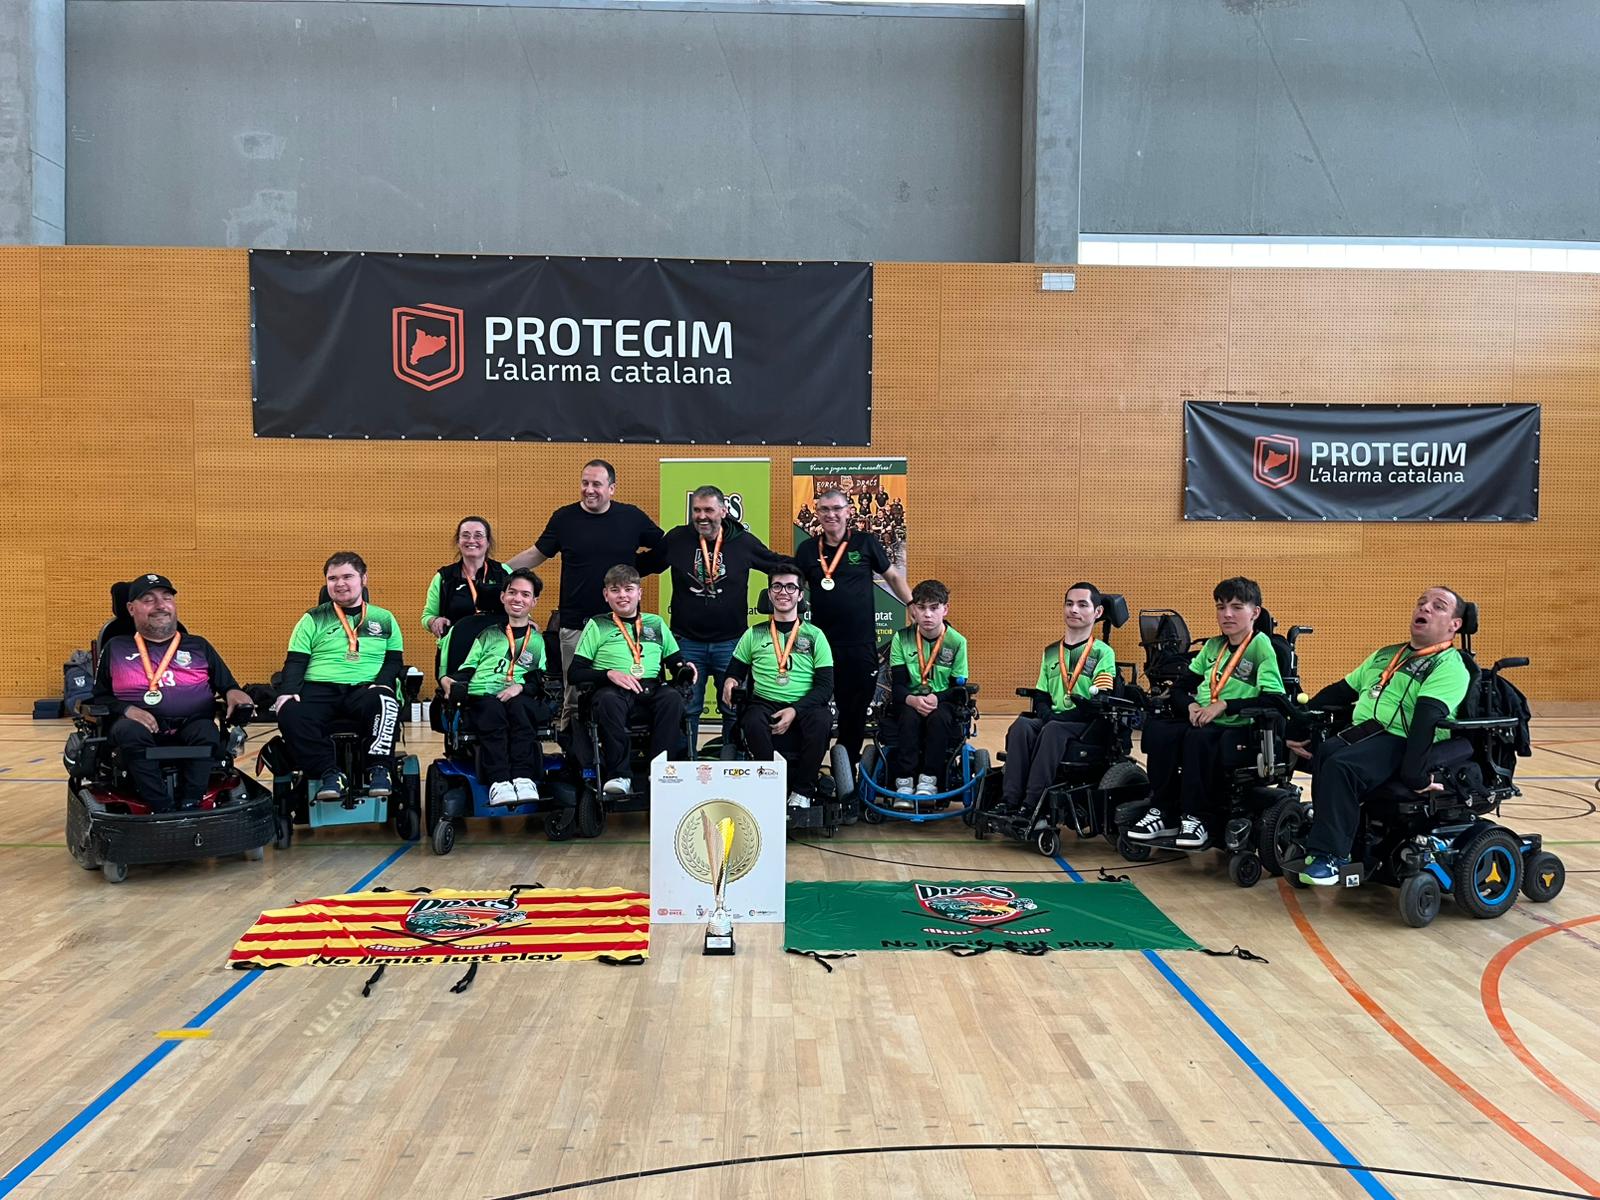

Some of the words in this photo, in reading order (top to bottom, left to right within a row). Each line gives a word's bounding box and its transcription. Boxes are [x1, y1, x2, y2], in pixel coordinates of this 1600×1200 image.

[485, 315, 733, 360] PROTEGIM
[610, 359, 732, 385] catalana
[1310, 441, 1467, 467] PROTEGIM
[1388, 468, 1465, 484] catalana
[494, 658, 506, 674] 8
[916, 884, 1015, 900] DRACS
[408, 898, 518, 915] DRACS
[881, 939, 918, 948] No
[1057, 939, 1115, 949] play
[312, 956, 351, 965] No
[357, 955, 434, 965] limits
[439, 954, 493, 964] just
[500, 952, 563, 962] play
